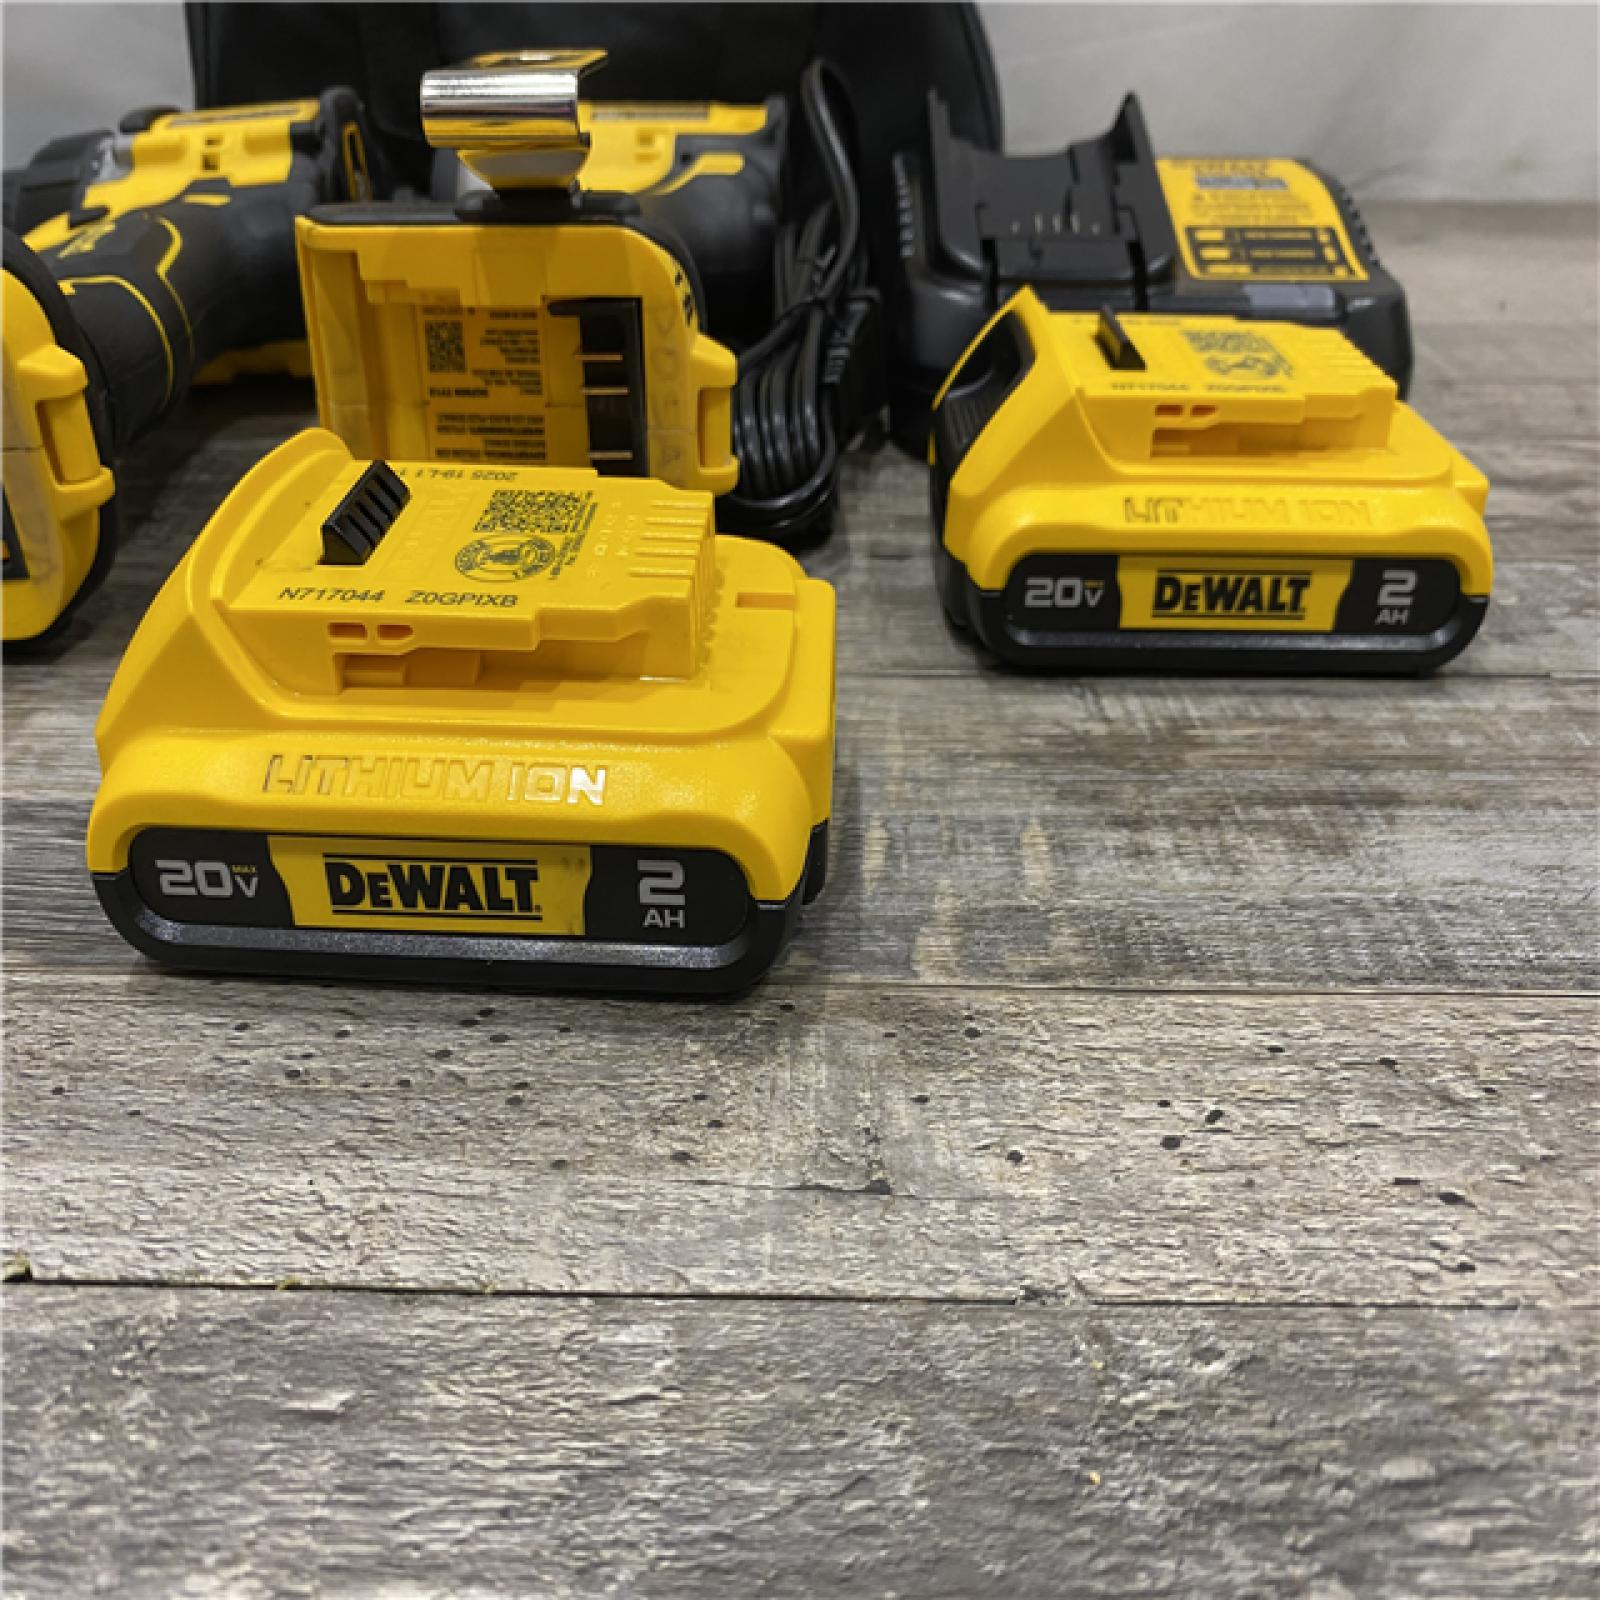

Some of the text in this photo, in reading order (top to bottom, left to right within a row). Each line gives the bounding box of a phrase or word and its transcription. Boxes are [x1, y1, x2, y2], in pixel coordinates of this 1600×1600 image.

[278, 586, 386, 604] N717044
[1377, 569, 1418, 606] 2
[1375, 607, 1410, 625] AH
[261, 754, 608, 806] LITHIUM ION
[636, 858, 686, 907] 2
[641, 908, 686, 929] AH
